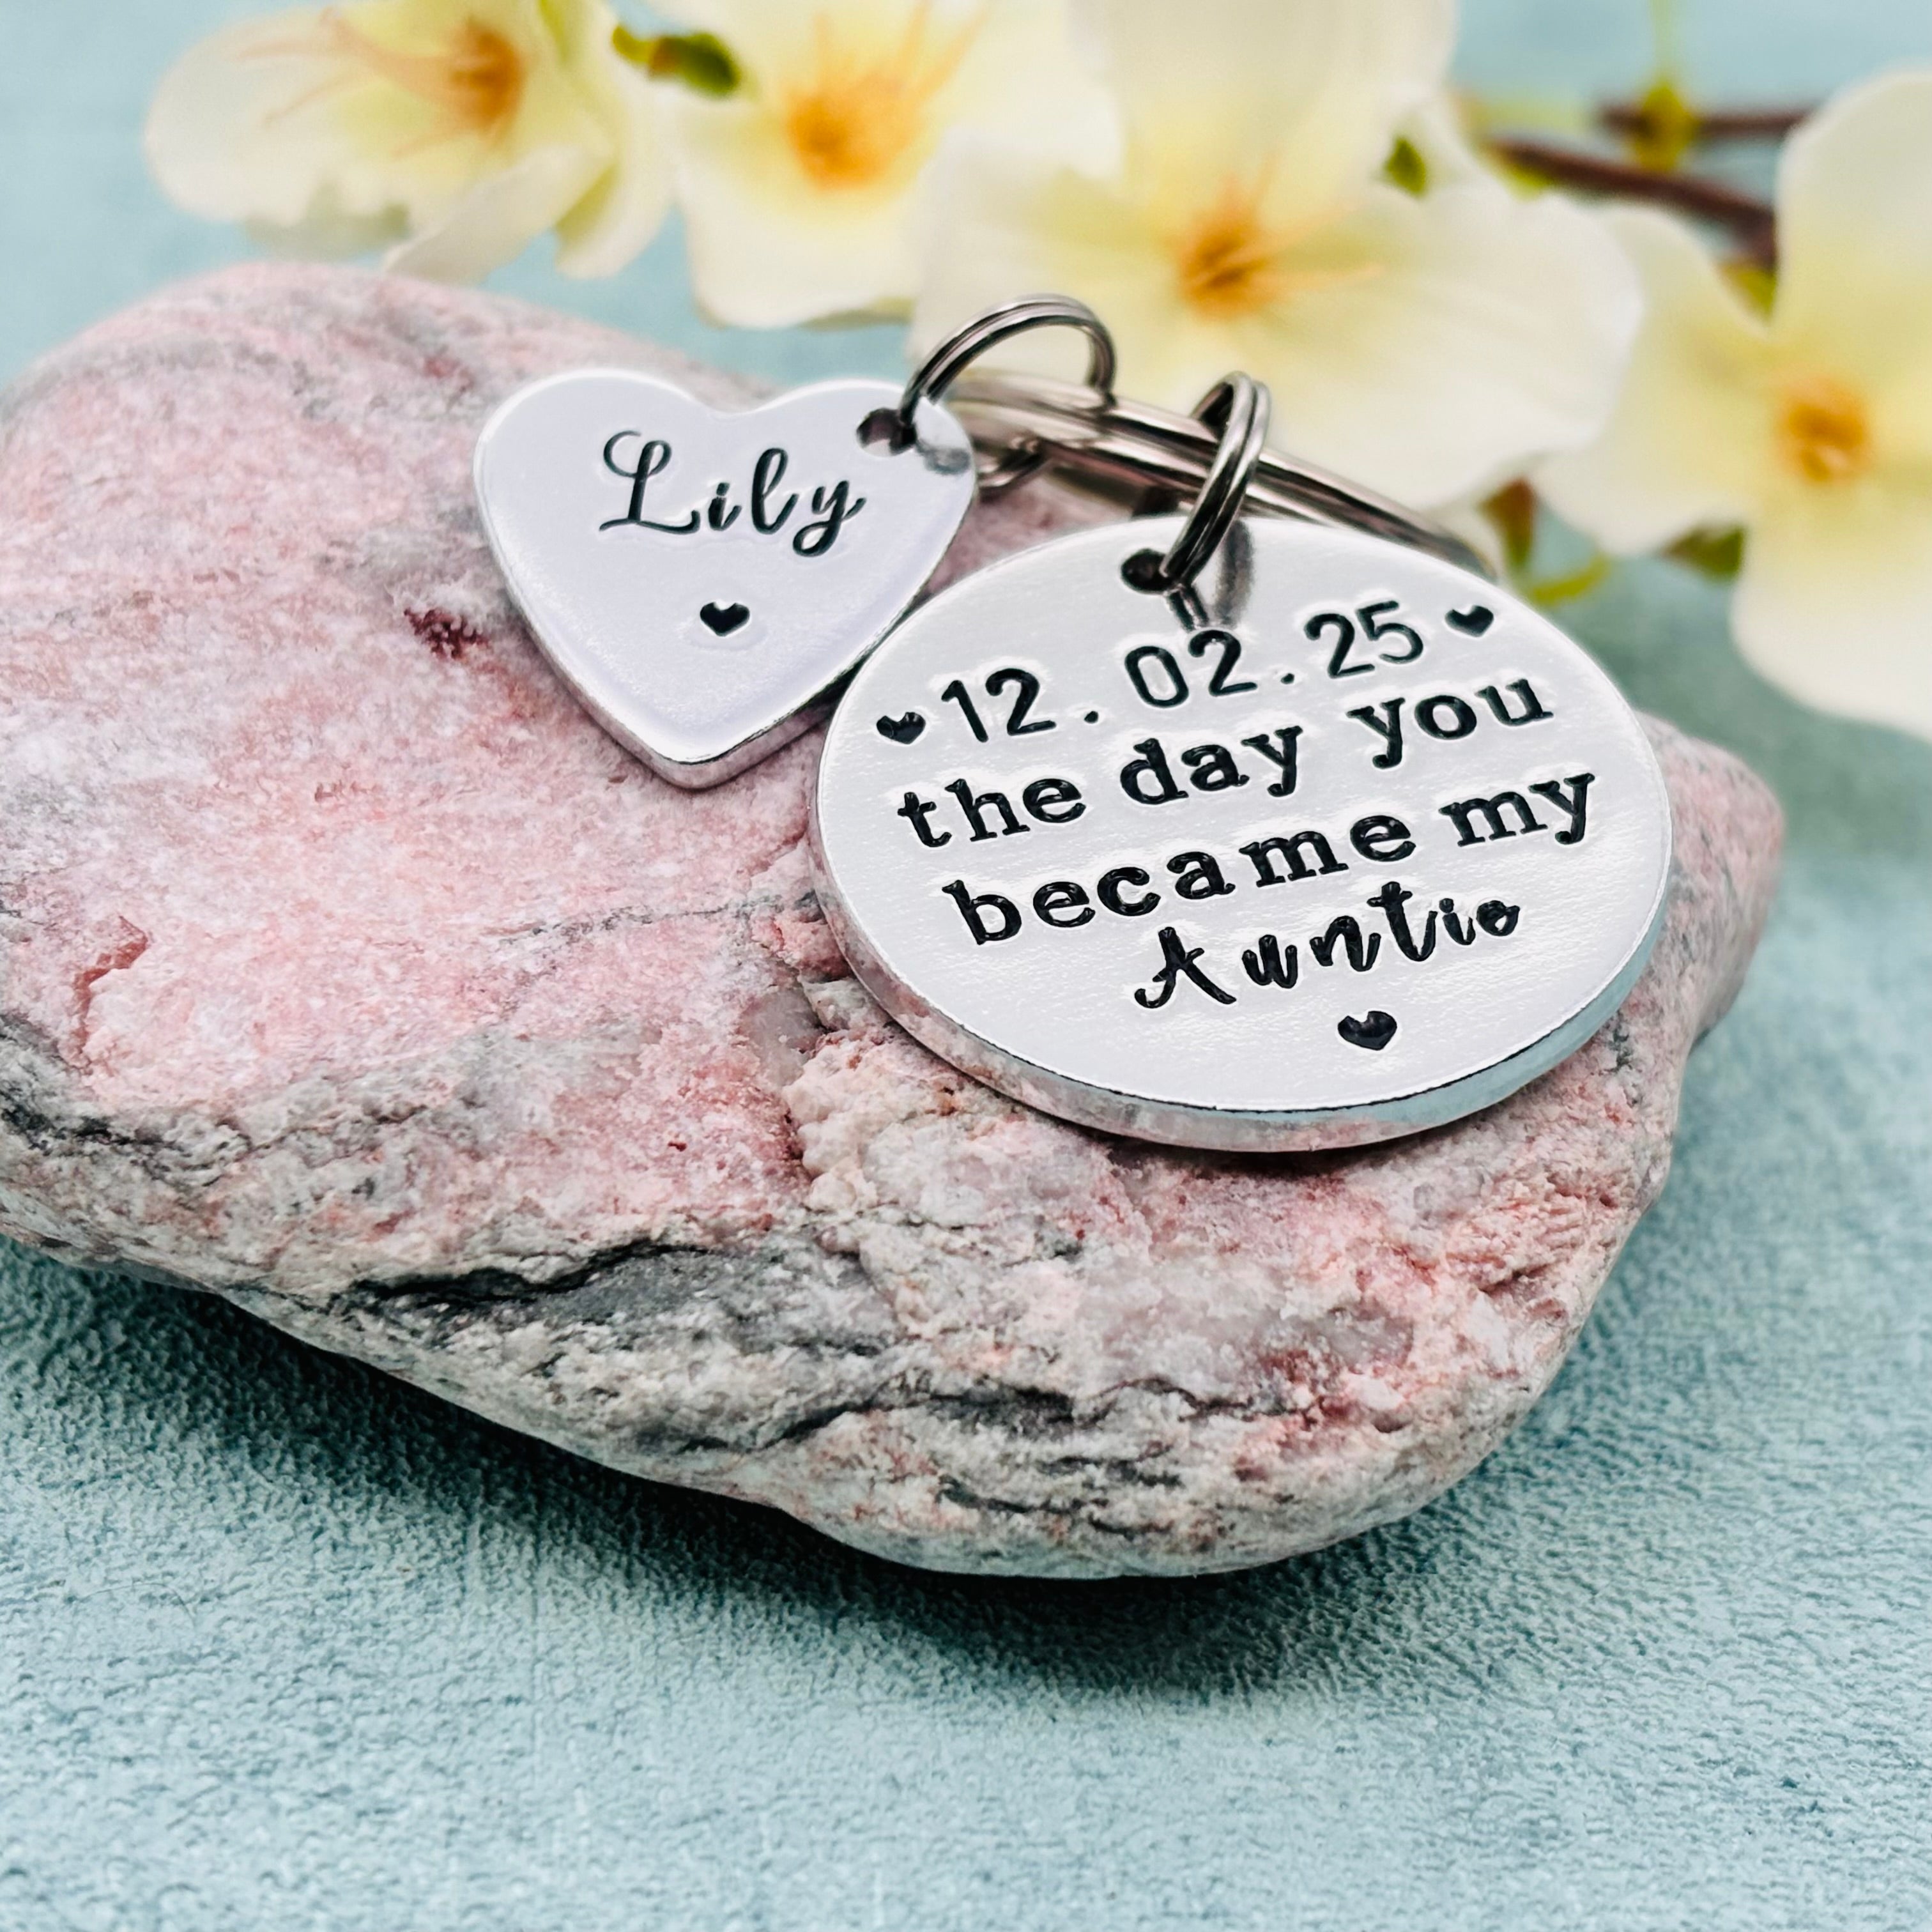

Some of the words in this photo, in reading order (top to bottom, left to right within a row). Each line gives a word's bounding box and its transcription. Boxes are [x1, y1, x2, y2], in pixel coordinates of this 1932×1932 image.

[599, 430, 866, 556] Lily
[897, 778, 1087, 848] the
[1119, 723, 1303, 806] day
[1347, 676, 1554, 769] you
[941, 813, 1417, 946] became
[1439, 772, 1596, 845] my
[1133, 880, 1522, 1009] Auntie
